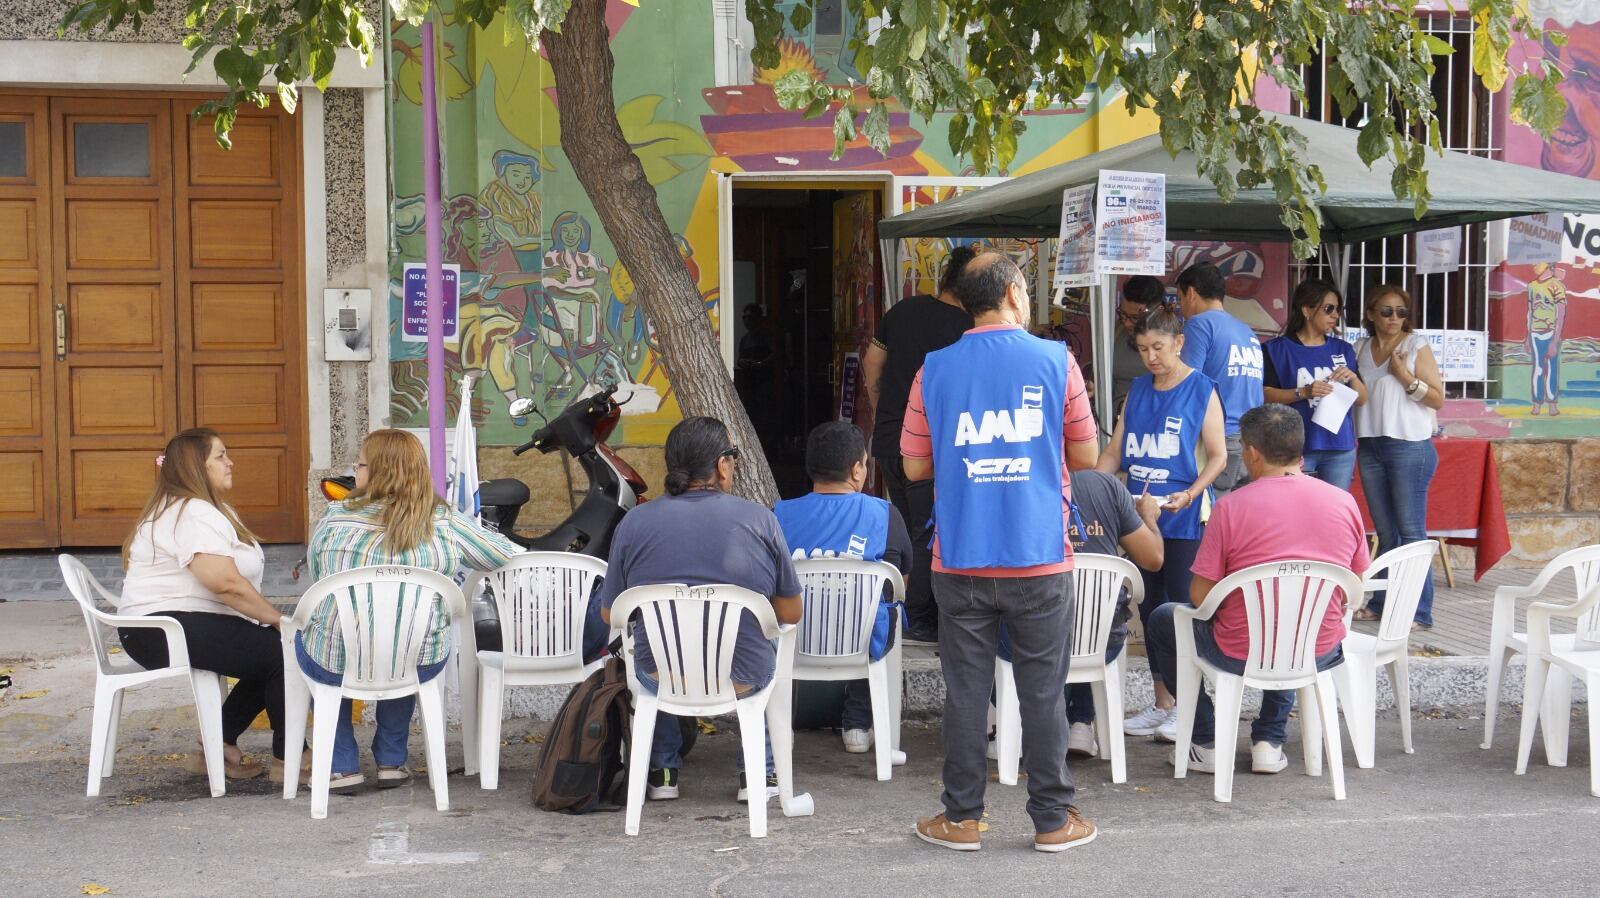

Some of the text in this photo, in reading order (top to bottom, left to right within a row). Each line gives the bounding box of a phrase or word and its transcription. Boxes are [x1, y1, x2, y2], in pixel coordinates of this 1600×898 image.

[954, 408, 1044, 447] AMP
[1125, 432, 1180, 459] AMP
[992, 475, 1030, 483] trabajadores
